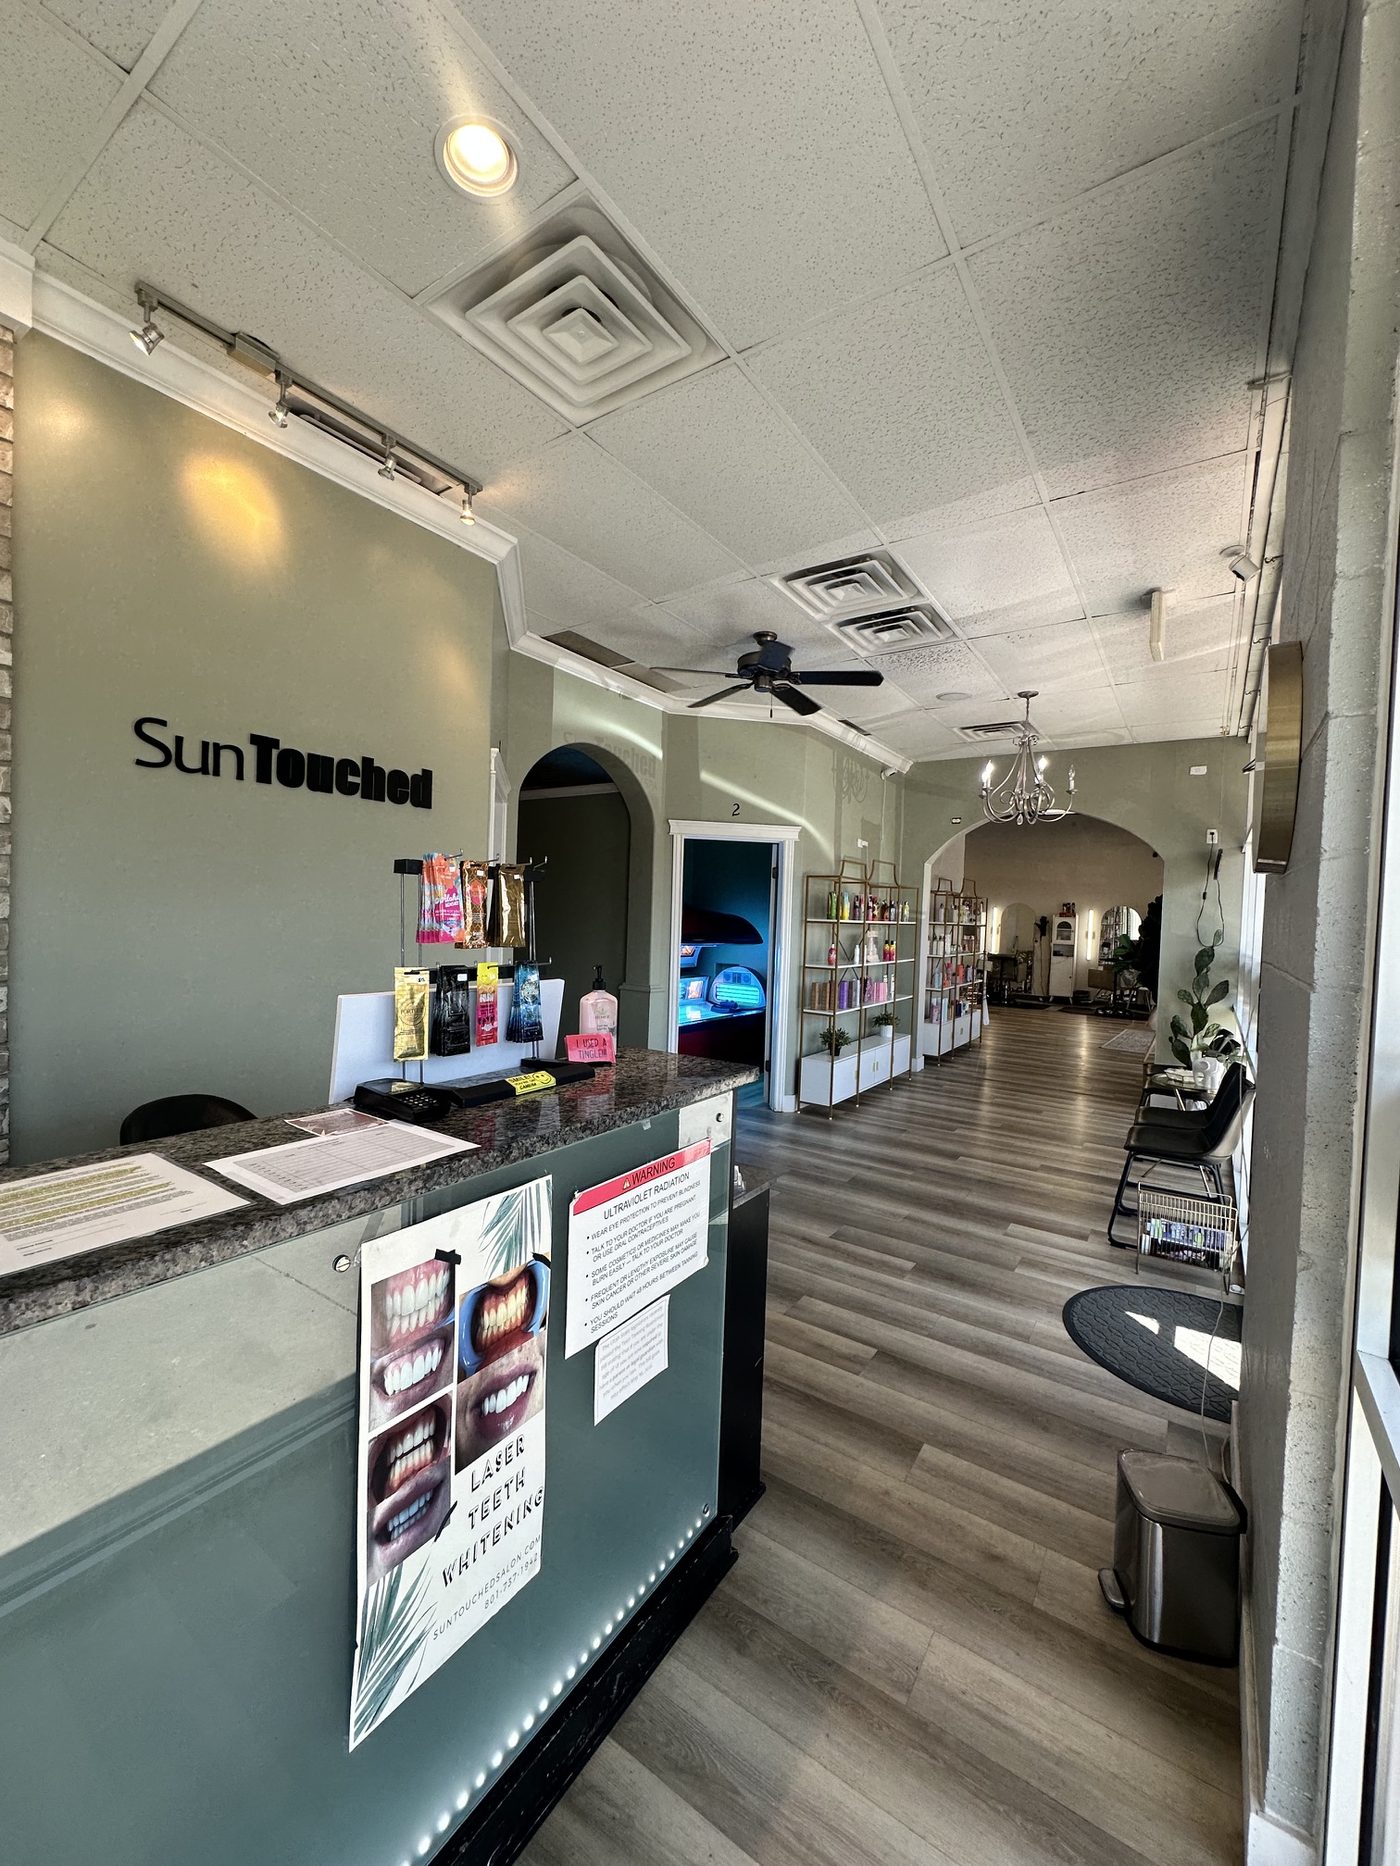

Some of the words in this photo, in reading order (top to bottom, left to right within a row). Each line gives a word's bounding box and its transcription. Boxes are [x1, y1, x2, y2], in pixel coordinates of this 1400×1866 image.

[731, 803, 740, 816] 2
[583, 1037, 599, 1049] USED
[602, 1038, 608, 1047] A
[604, 1187, 651, 1220] ULTRAVIOLET
[654, 1170, 689, 1194] RADIATION
[632, 1156, 675, 1185] WARNING
[591, 1226, 607, 1241] WEAR
[609, 1220, 619, 1231] EYE
[620, 1204, 649, 1225] PROTECTION
[650, 1201, 656, 1210] TO
[657, 1190, 677, 1206] PREVENT
[679, 1179, 700, 1195] BLINDNESS
[591, 1241, 604, 1255] TALK
[605, 1236, 612, 1247] TO
[614, 1229, 627, 1242] YOUR
[628, 1218, 647, 1234] DOCTOR
[653, 1209, 663, 1221] YOU
[664, 1205, 672, 1215] ARE
[673, 1193, 695, 1210] PREGNANT
[592, 1252, 601, 1263] OR
[602, 1245, 612, 1257] USE
[614, 1238, 626, 1251] ORAL
[627, 1215, 668, 1243] CONTRACEPTIVES
[590, 1278, 619, 1302] FREQUENT
[620, 1272, 627, 1283] OR
[627, 1259, 648, 1278] LENGTHY
[649, 1244, 673, 1264] EXPOSURE
[675, 1238, 683, 1249] MAY
[684, 1230, 696, 1244] CAUSE
[591, 1262, 607, 1278] SOME
[608, 1246, 636, 1268] COSMETICS
[637, 1241, 643, 1251] OR
[644, 1227, 669, 1247] MEDICINES
[670, 1221, 678, 1232] MAY
[680, 1215, 691, 1227] MAKE
[591, 1295, 605, 1310] SKIN
[606, 1281, 626, 1301] CANCER
[627, 1277, 633, 1287] OR
[634, 1266, 650, 1282] OTHER
[650, 1254, 668, 1272] SEVERE
[670, 1248, 679, 1260] SKIN
[681, 1238, 696, 1253] DAMAGE
[592, 1270, 608, 1286] BURN
[608, 1260, 625, 1277] EASILY
[632, 1249, 642, 1262] TALK
[643, 1245, 649, 1255] TO
[650, 1237, 663, 1251] YOUR
[664, 1226, 683, 1243] DOCTOR
[590, 1312, 601, 1326] YOU
[603, 1297, 624, 1318] SHOULD
[643, 1274, 658, 1291] HOURS
[660, 1260, 680, 1280] BETWEEN
[681, 1250, 697, 1266] TANNING
[590, 1309, 618, 1334] SESSIONS
[470, 1431, 525, 1493] LASER
[468, 1465, 525, 1532] TEETH
[441, 1482, 544, 1591] WHITENING
